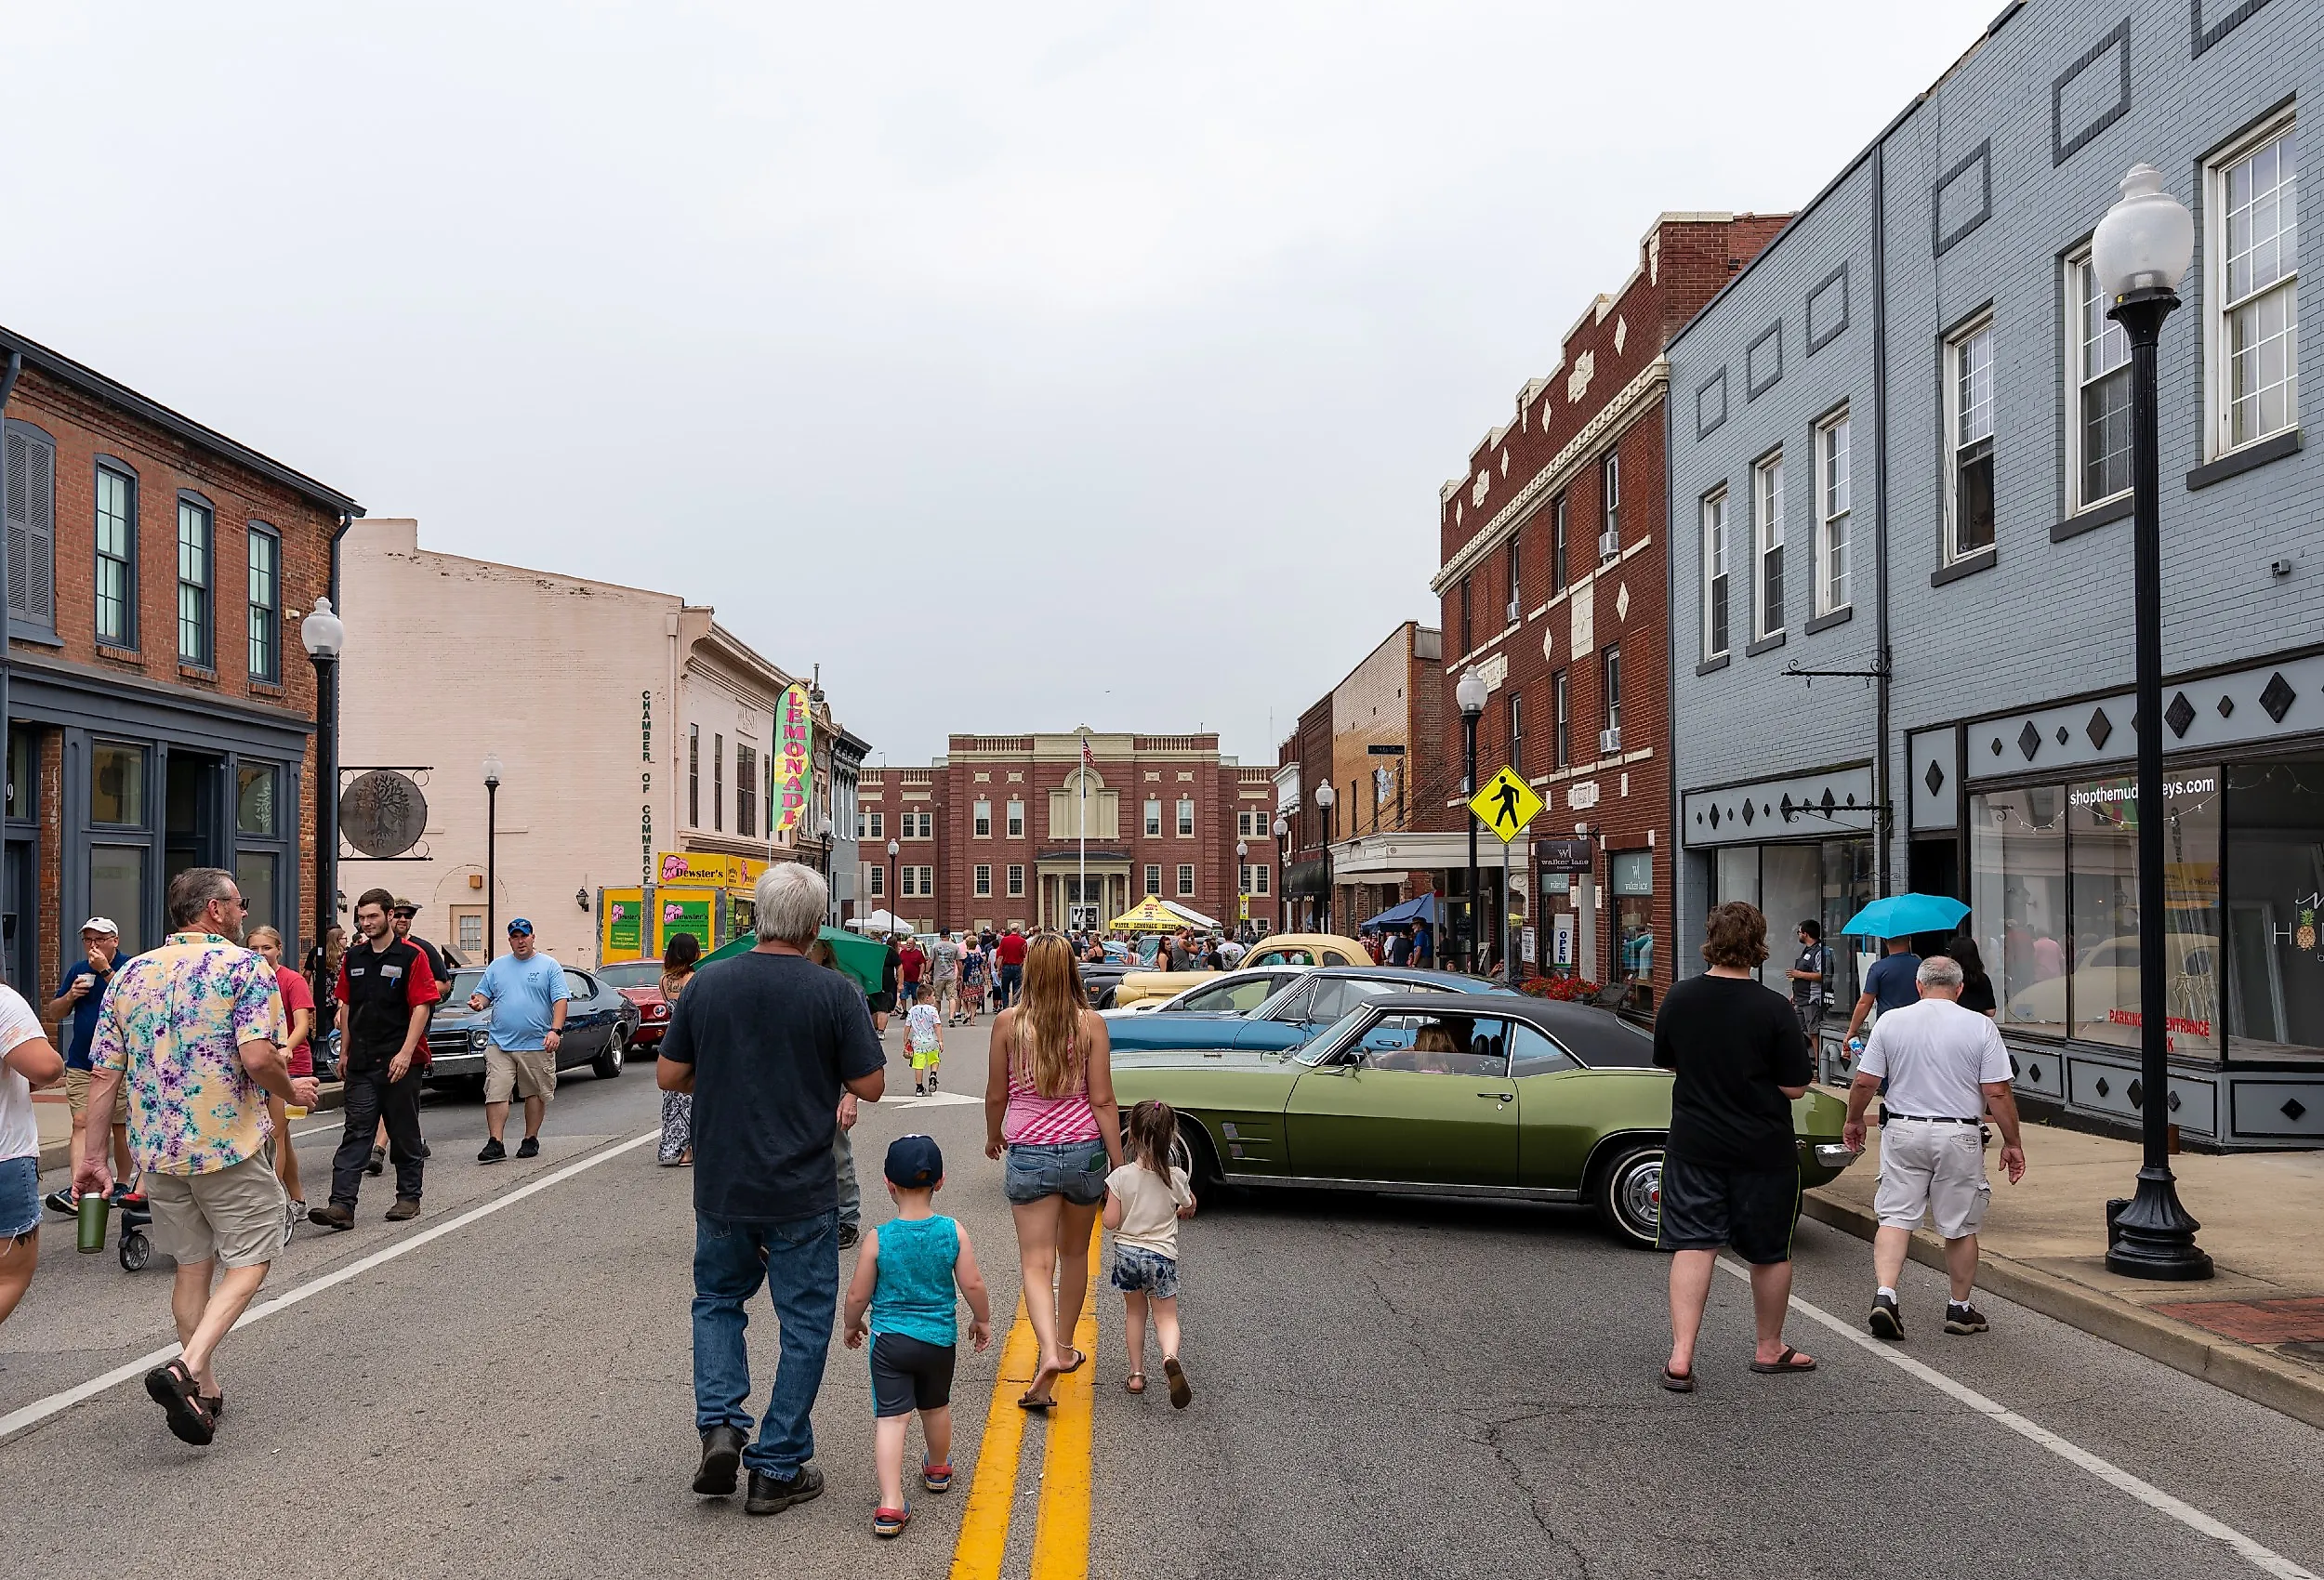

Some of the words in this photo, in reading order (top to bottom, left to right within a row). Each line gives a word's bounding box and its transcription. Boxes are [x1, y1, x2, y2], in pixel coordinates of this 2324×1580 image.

[641, 690, 652, 762] CHAMBER
[782, 691, 807, 825] LEMONADE
[641, 772, 651, 794] OF
[2069, 778, 2214, 806] shopthemudeys.com
[641, 804, 652, 885] COMMERCE
[676, 867, 724, 878] Dewster's
[674, 912, 709, 921] Dewster's
[1558, 930, 1567, 964] OPEN
[2165, 1016, 2210, 1037] ENTRANCE
